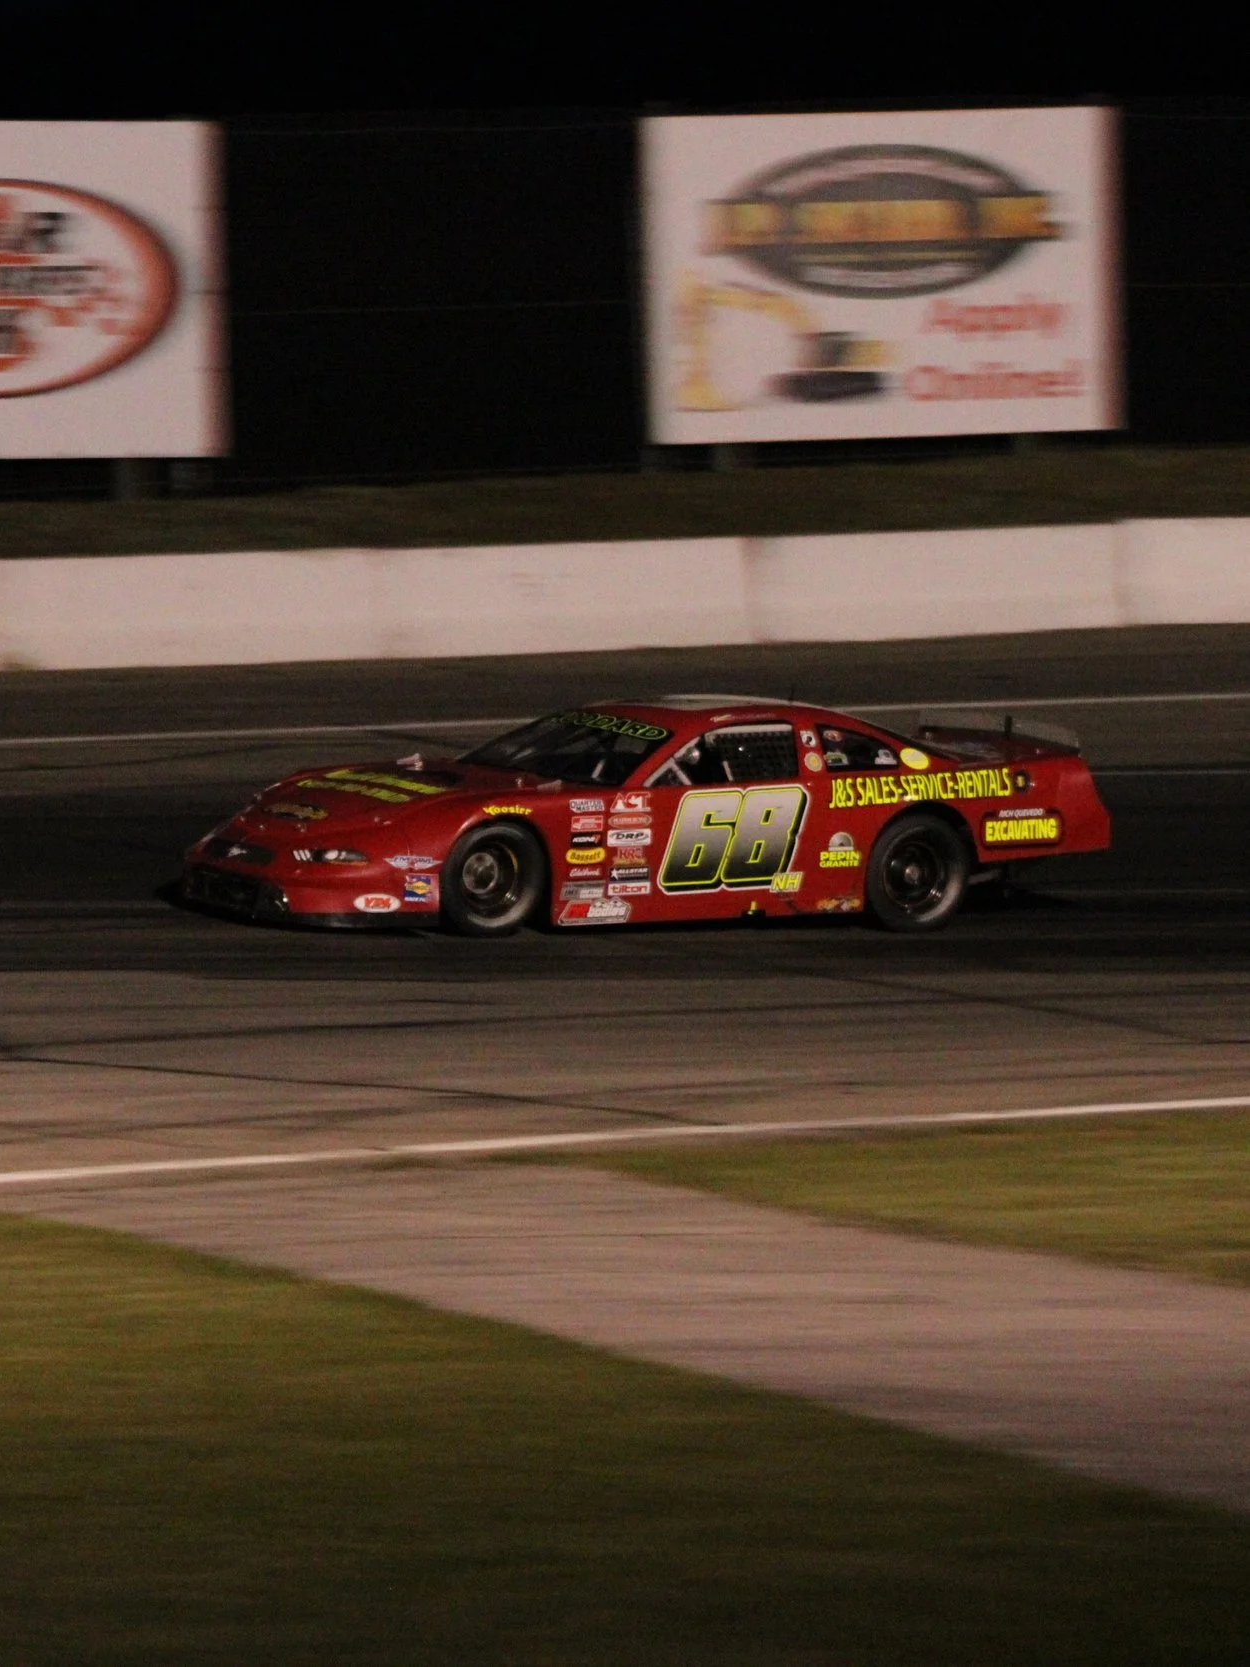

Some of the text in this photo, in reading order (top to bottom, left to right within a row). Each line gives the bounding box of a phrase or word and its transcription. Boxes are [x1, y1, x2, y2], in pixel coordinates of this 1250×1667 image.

[829, 778, 854, 809] J&S
[615, 832, 644, 840] DRP
[985, 818, 1058, 842] EXCAVATING
[658, 785, 809, 894] 68
[819, 851, 861, 861] PEPIN
[819, 860, 860, 868] GRANITE
[771, 873, 802, 891] NH
